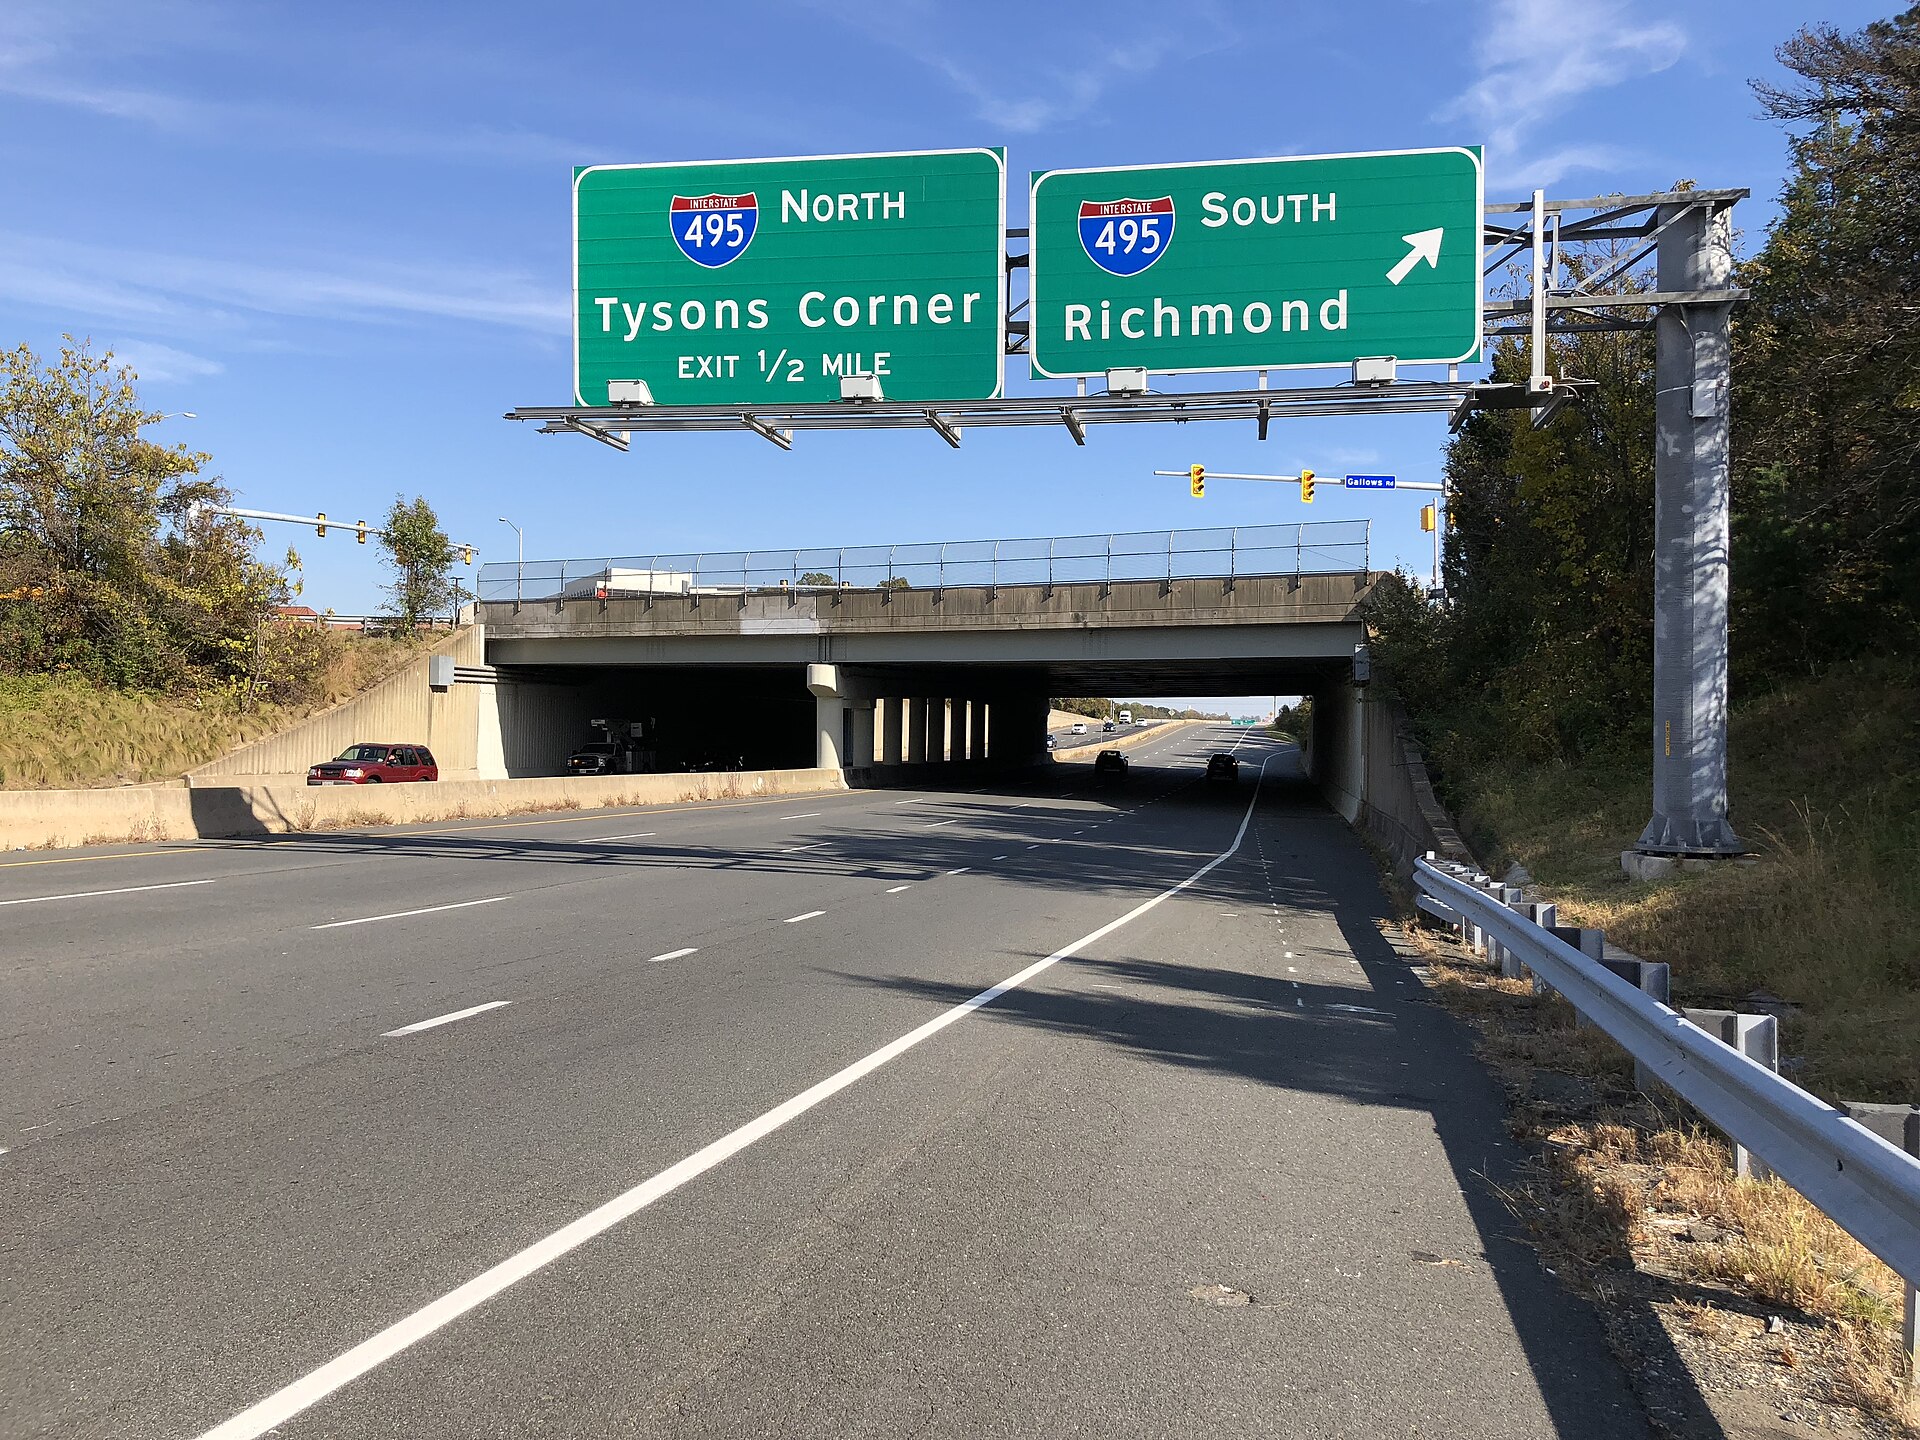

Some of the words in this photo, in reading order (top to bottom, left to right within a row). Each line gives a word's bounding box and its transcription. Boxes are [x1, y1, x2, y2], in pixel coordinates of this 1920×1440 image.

[689, 197, 739, 209] INTERSTATE
[781, 188, 905, 223] NORTH
[1099, 201, 1153, 215] INTERSTATE
[1200, 191, 1336, 228] SOUTH
[684, 213, 744, 248] 495
[1095, 217, 1161, 255] 495
[594, 297, 769, 342] Tysons
[798, 291, 981, 328] Corner
[1065, 289, 1348, 341] Richmond
[678, 355, 740, 379] EXIT
[822, 352, 891, 376] MILE
[1347, 478, 1383, 487] Gallows
